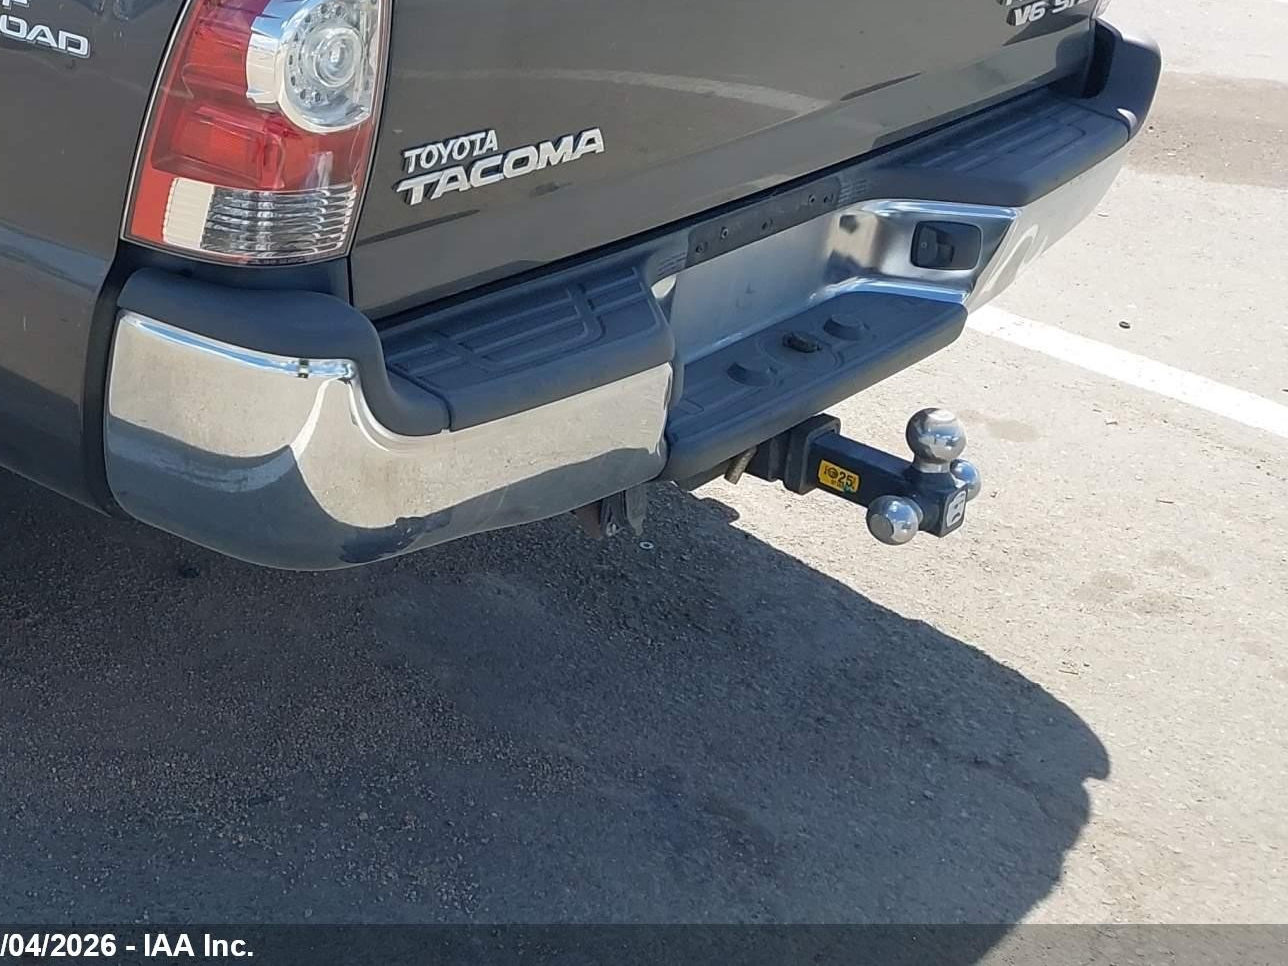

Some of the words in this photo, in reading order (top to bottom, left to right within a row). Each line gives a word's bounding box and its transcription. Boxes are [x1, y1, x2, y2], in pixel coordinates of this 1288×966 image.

[1012, 0, 1047, 26] V6
[395, 127, 605, 206] TACOMA
[403, 129, 499, 174] TOYOTA
